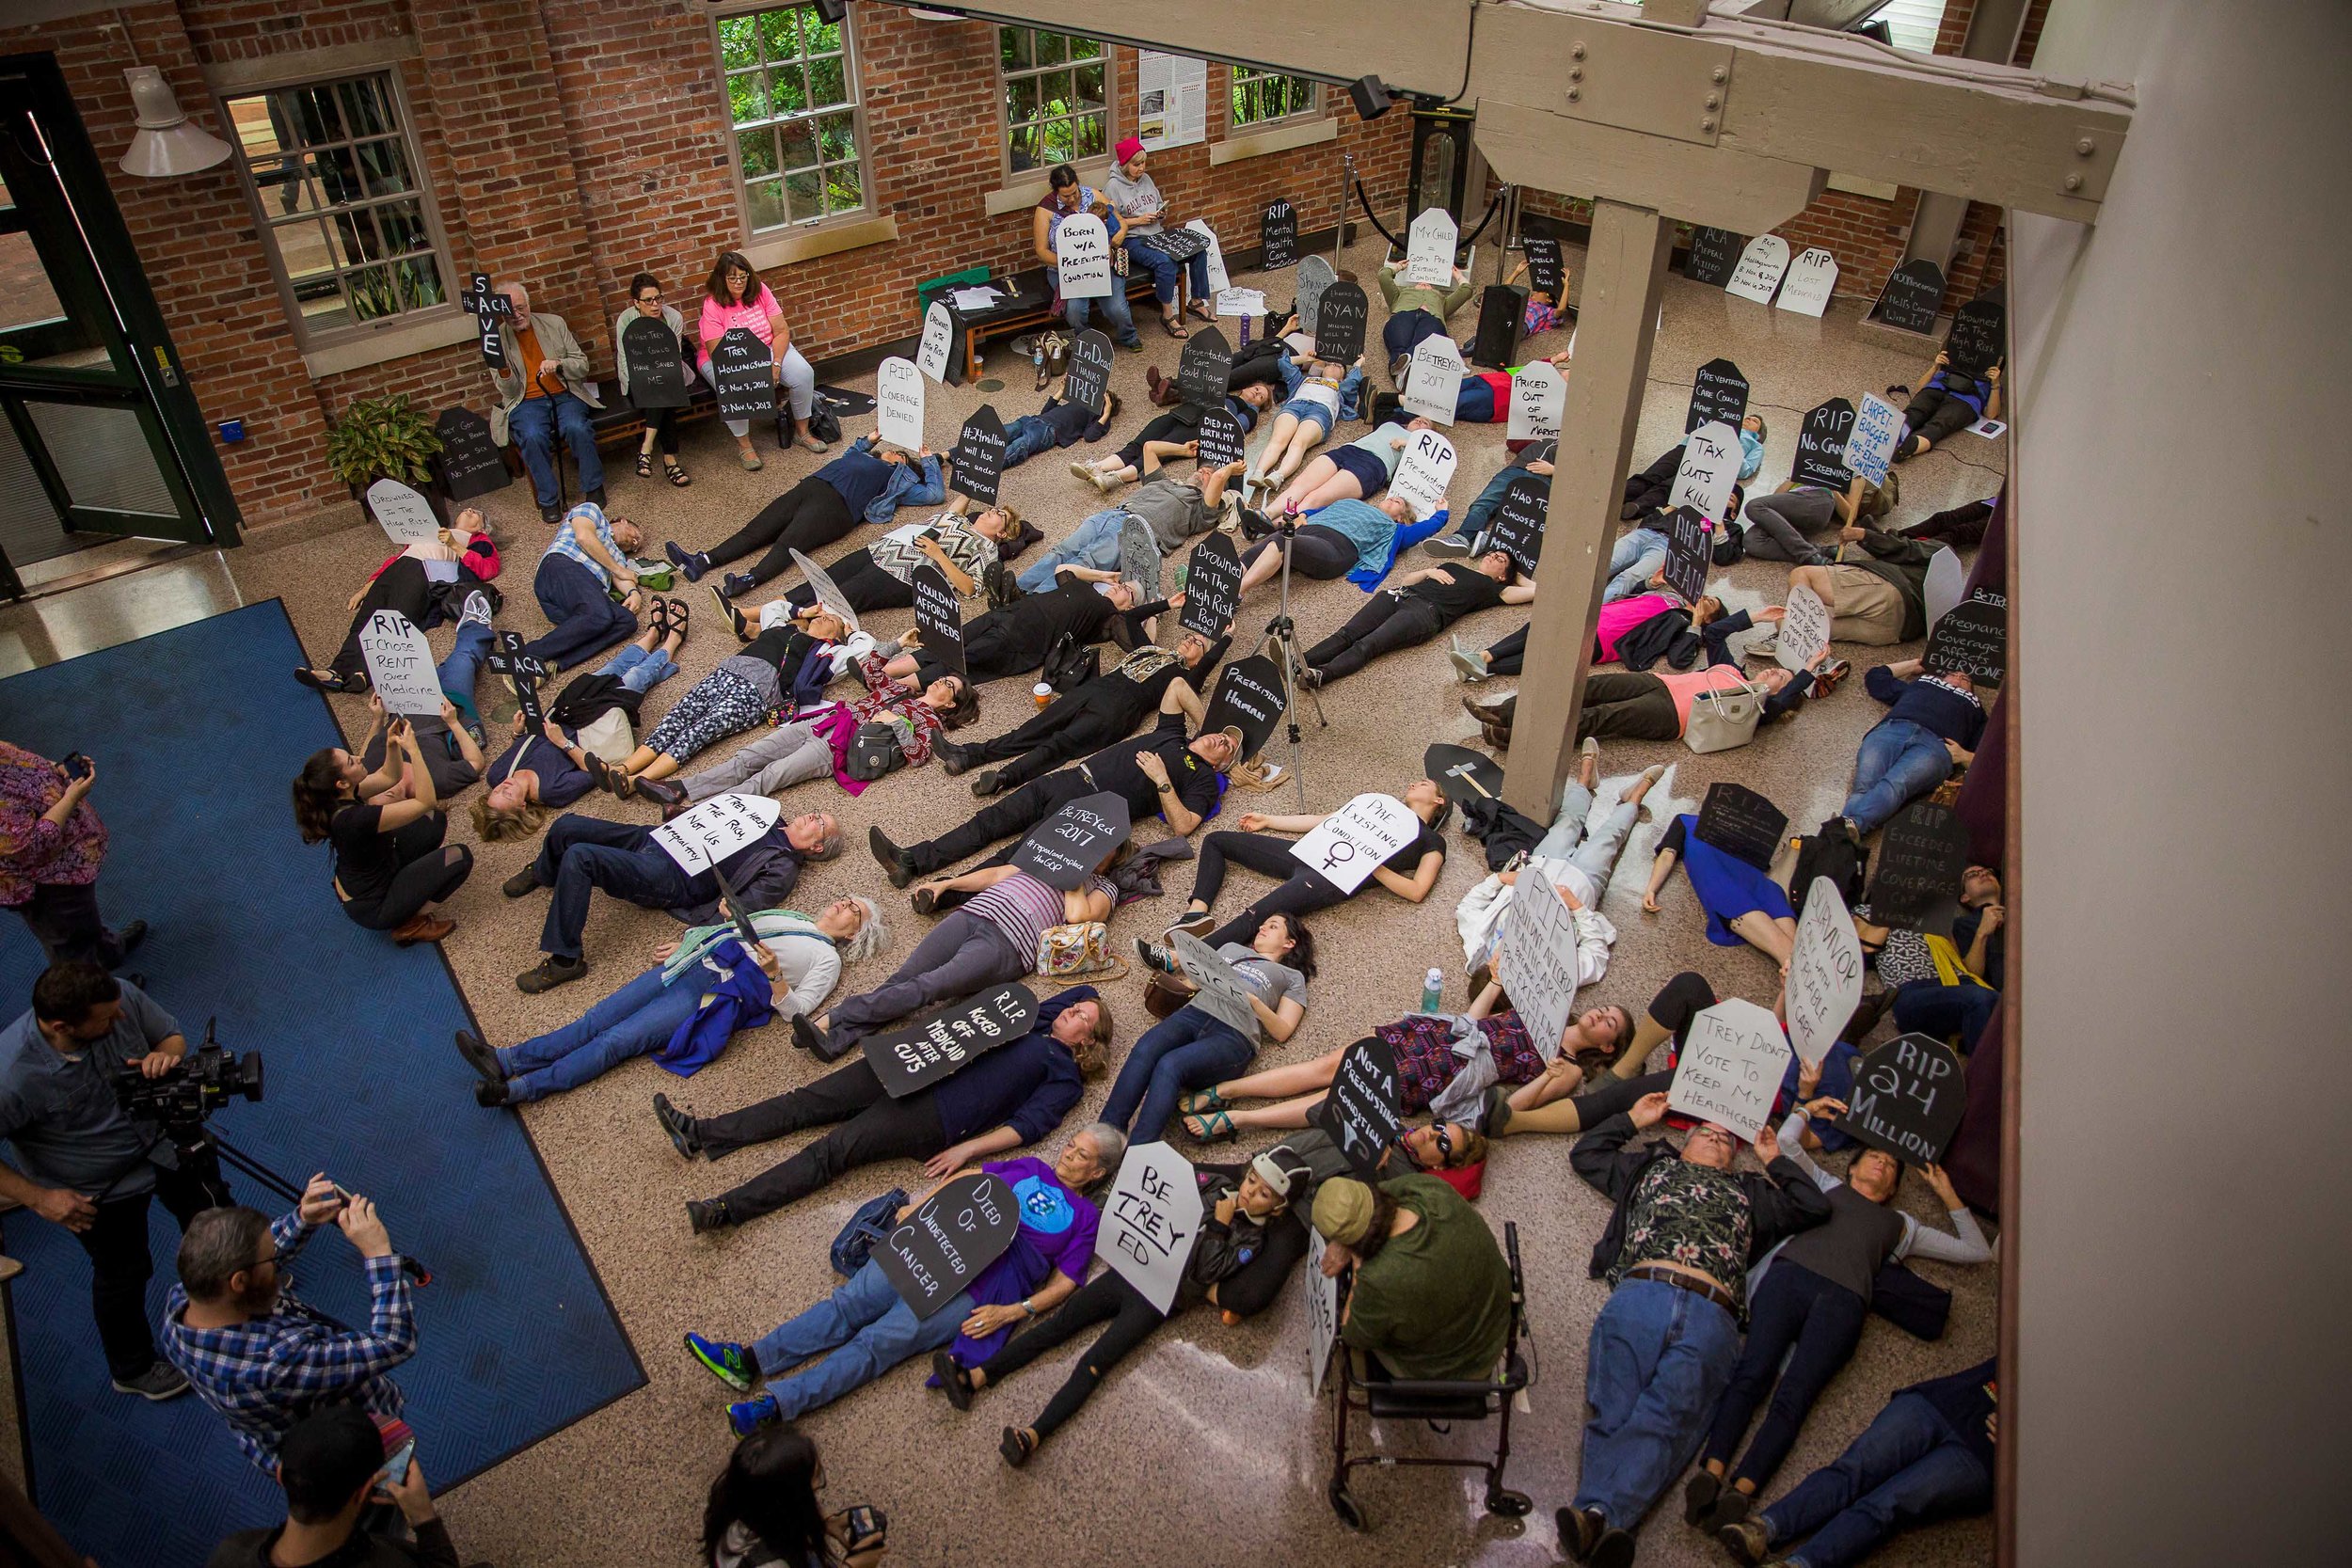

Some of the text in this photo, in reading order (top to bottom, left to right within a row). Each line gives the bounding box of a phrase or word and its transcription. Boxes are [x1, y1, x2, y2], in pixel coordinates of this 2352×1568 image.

[1126, 198, 1141, 215] BALL
[1268, 203, 1290, 220] RIP
[1063, 227, 1094, 238] BORN
[1266, 223, 1293, 236] Mental
[1432, 228, 1454, 241] CHILD
[1705, 227, 1727, 245] ACA
[1266, 237, 1293, 250] Health
[1694, 238, 1724, 261] REPEAL
[1268, 250, 1288, 261] Care
[1692, 254, 1721, 272] KILLED
[1803, 251, 1831, 268] RIP
[1063, 272, 1104, 283] CONDITION
[1408, 273, 1449, 284] CONDITION
[1696, 269, 1712, 281] ME
[1797, 273, 1820, 286] LOST
[1784, 284, 1822, 302] MEDICAID
[463, 296, 511, 314] the ACA
[475, 277, 500, 356] SAVE
[1324, 301, 1366, 319] RYAN
[1957, 309, 1999, 328] Drowned
[1972, 325, 1988, 339] The
[724, 346, 748, 357] TREY
[1184, 342, 1232, 365] Preventative
[1951, 336, 1994, 354] High Risk
[1193, 357, 1210, 368] Care
[1958, 352, 1979, 363] Pool
[647, 376, 664, 385] ME
[889, 363, 914, 381] RIP
[1073, 358, 1101, 385] THANKS
[1180, 365, 1223, 384] Could Have
[1422, 372, 1445, 389] 2017
[1515, 376, 1548, 388] PRICED
[1698, 369, 1747, 389] PREVENTATIVE
[881, 384, 919, 407] COVERAGE
[1068, 374, 1099, 407] TREY
[1522, 391, 1544, 402] OUT
[1695, 385, 1740, 405] CARE COULD
[886, 406, 914, 423] DENIED
[1528, 416, 1549, 424] THE
[1693, 402, 1740, 421] HAVE SAVED
[1813, 407, 1853, 432] RIP
[1204, 416, 1234, 432] DIED AT
[1530, 425, 1561, 437] MARKET
[1858, 417, 1890, 446] BAGGER
[962, 426, 1006, 447] #24million
[1200, 440, 1244, 456] MOM HAD NO
[1222, 433, 1235, 443] MY
[1695, 436, 1724, 459] TAX
[964, 445, 993, 462] will lose
[1418, 434, 1453, 465] RIP
[974, 463, 996, 475] under
[1404, 456, 1446, 496] Pre-existing
[1680, 460, 1713, 483] CUTS
[1804, 458, 1851, 481] SCREENING
[1849, 454, 1885, 485] CONDITION
[956, 470, 995, 496] Trumpcare
[1397, 472, 1438, 505] Condition
[371, 493, 415, 504] DROWNED
[1510, 486, 1532, 505] HAD
[1684, 485, 1710, 512] KILL
[1502, 505, 1535, 527] CHOOSE
[400, 529, 423, 537] POOL
[1496, 522, 1516, 540] FOOD
[1675, 514, 1708, 562] AHCA
[1198, 543, 1242, 579] Drowned
[1194, 565, 1229, 594] In The
[1665, 548, 1705, 601] DEATH
[916, 595, 948, 620] AFFORD
[1188, 583, 1234, 619] High Risk
[1807, 600, 1825, 619] GOP
[373, 614, 411, 639] RIP
[916, 610, 961, 641] MY MEDS
[1198, 608, 1219, 629] Pool
[1789, 609, 1804, 628] TAX
[363, 639, 416, 653] I Chose
[1936, 630, 2001, 653] Coverage
[376, 656, 419, 670] RENT
[489, 656, 545, 674] THE ACA
[1942, 645, 1990, 664] Affects
[506, 634, 537, 718] SAVE
[1929, 653, 2004, 681] EVERYONE
[379, 683, 437, 696] Medicine
[1226, 667, 1284, 711] PREEXISTING
[706, 802, 725, 819] THE
[723, 794, 770, 830] TREY HELPS
[1058, 805, 1116, 836] BeTREYed
[1366, 798, 1397, 825] PRE
[1911, 804, 1947, 829] RIP
[687, 814, 707, 832] NOT
[1343, 803, 1398, 848] EXISTING
[1055, 823, 1095, 847] 2017
[1323, 816, 1382, 861] CONDITION
[1888, 827, 1955, 854] EXCEEDED
[1885, 848, 1946, 873] LIFETIME
[1880, 868, 1955, 895] COVERAGE
[1528, 870, 1569, 942] RIP
[1811, 879, 1858, 988] SURVIVOR
[1249, 967, 1272, 989] SCIENCE
[1543, 945, 1573, 994] AFFORD
[1186, 961, 1244, 1002] SICK
[951, 1019, 976, 1039] OFF
[967, 1006, 1002, 1037] KICKED
[1703, 1014, 1745, 1047] TREY
[914, 1040, 942, 1063] AFTER
[926, 1019, 966, 1062] MEDICAID
[894, 1042, 927, 1073] CUTS
[1695, 1043, 1759, 1083] VOTE TO
[1896, 1039, 1950, 1081] RIP
[1355, 1045, 1393, 1098] NOT A
[1343, 1058, 1400, 1131] PREEXISTING
[1682, 1066, 1763, 1106] KEEP MY
[1868, 1065, 1936, 1117] 24
[1338, 1085, 1383, 1149] CONDITION
[1683, 1090, 1764, 1132] HEALTHCARE
[1845, 1085, 1937, 1161] MILLION
[1140, 1164, 1174, 1203] BE
[972, 1178, 1002, 1226] DIED
[958, 1208, 977, 1233] OF
[1118, 1189, 1185, 1251] TREY
[918, 1196, 966, 1275] UNDETECTED
[1117, 1229, 1150, 1267] ED
[890, 1225, 940, 1298] CANCER
